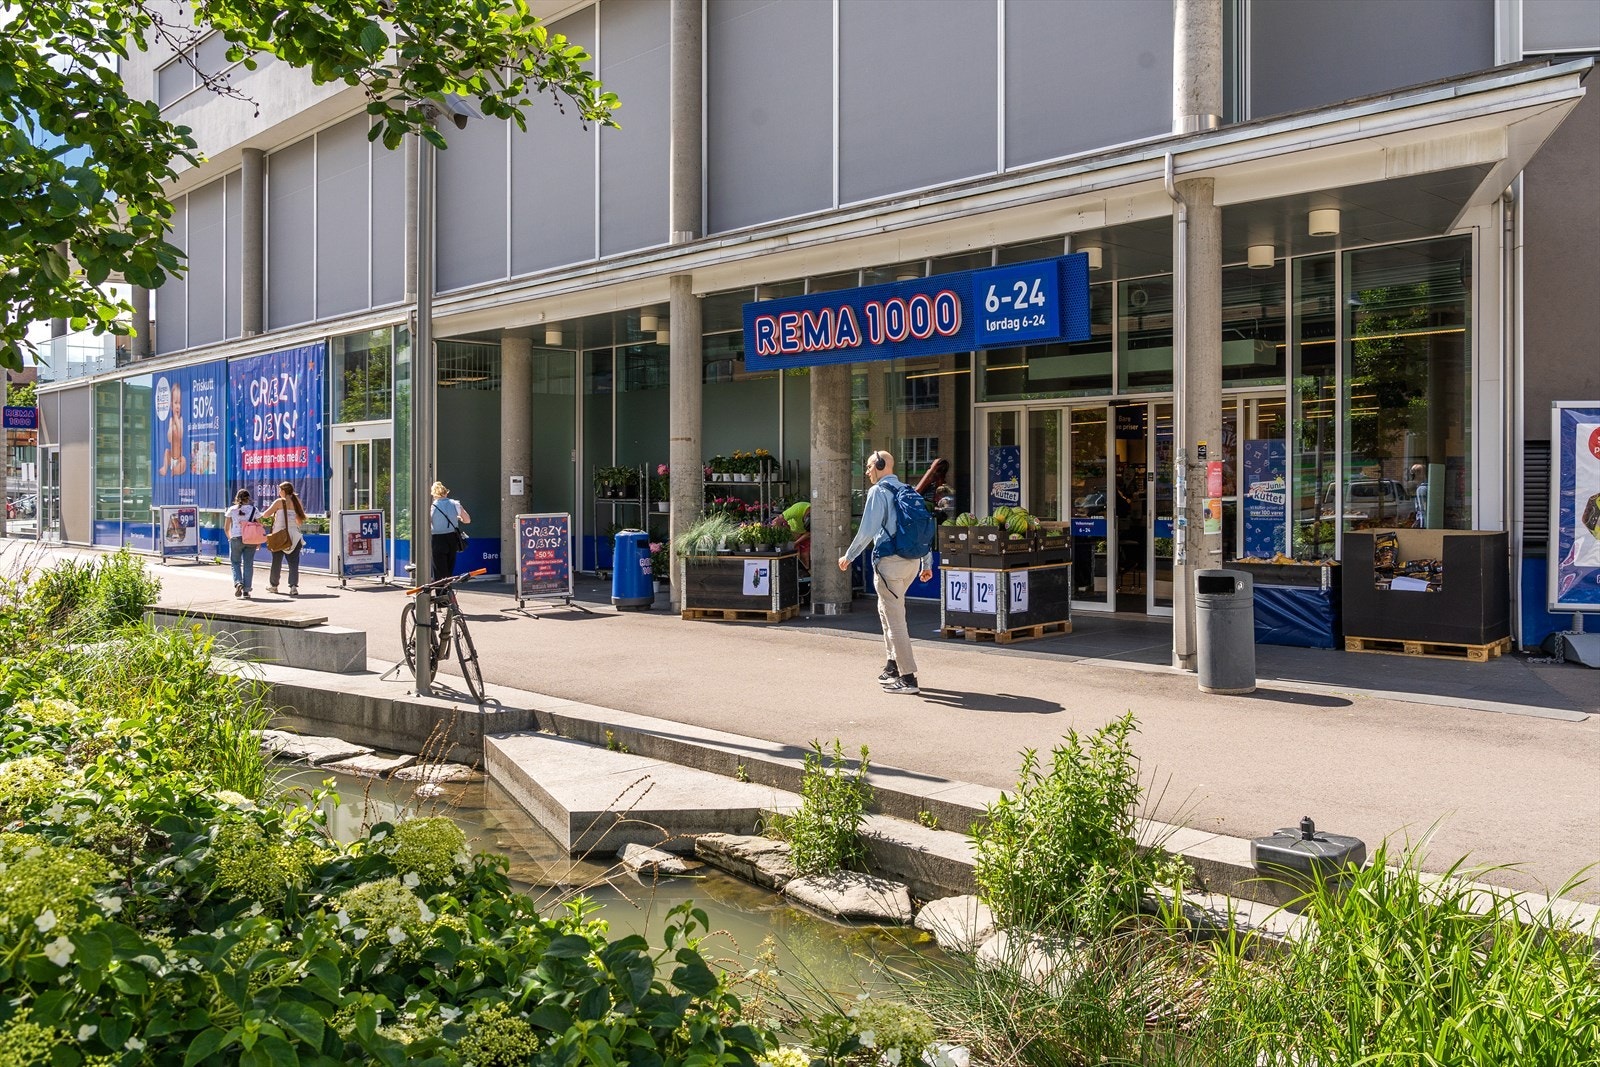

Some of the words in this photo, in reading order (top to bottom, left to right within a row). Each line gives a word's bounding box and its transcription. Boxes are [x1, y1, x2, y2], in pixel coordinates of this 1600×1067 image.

[985, 278, 1046, 313] 6-24
[755, 304, 861, 356] REMA
[866, 289, 962, 345] 1000
[986, 316, 1020, 332] lørdag
[1022, 314, 1046, 328] 6-24
[192, 378, 214, 393] Priskutt
[5, 409, 35, 418] REMA
[193, 395, 214, 419] 50%
[9, 417, 32, 426] 1000
[1122, 423, 1138, 431] priser
[1266, 482, 1284, 490] Juni-
[995, 489, 1017, 500] kuttet
[1254, 490, 1283, 503] kuttet
[180, 514, 189, 524] 99
[362, 522, 373, 535] 54
[482, 552, 499, 560] Bare
[950, 581, 962, 601] 12
[961, 582, 968, 590] 90
[977, 582, 988, 603] 12
[988, 583, 994, 592] 90
[1013, 581, 1023, 602] 12
